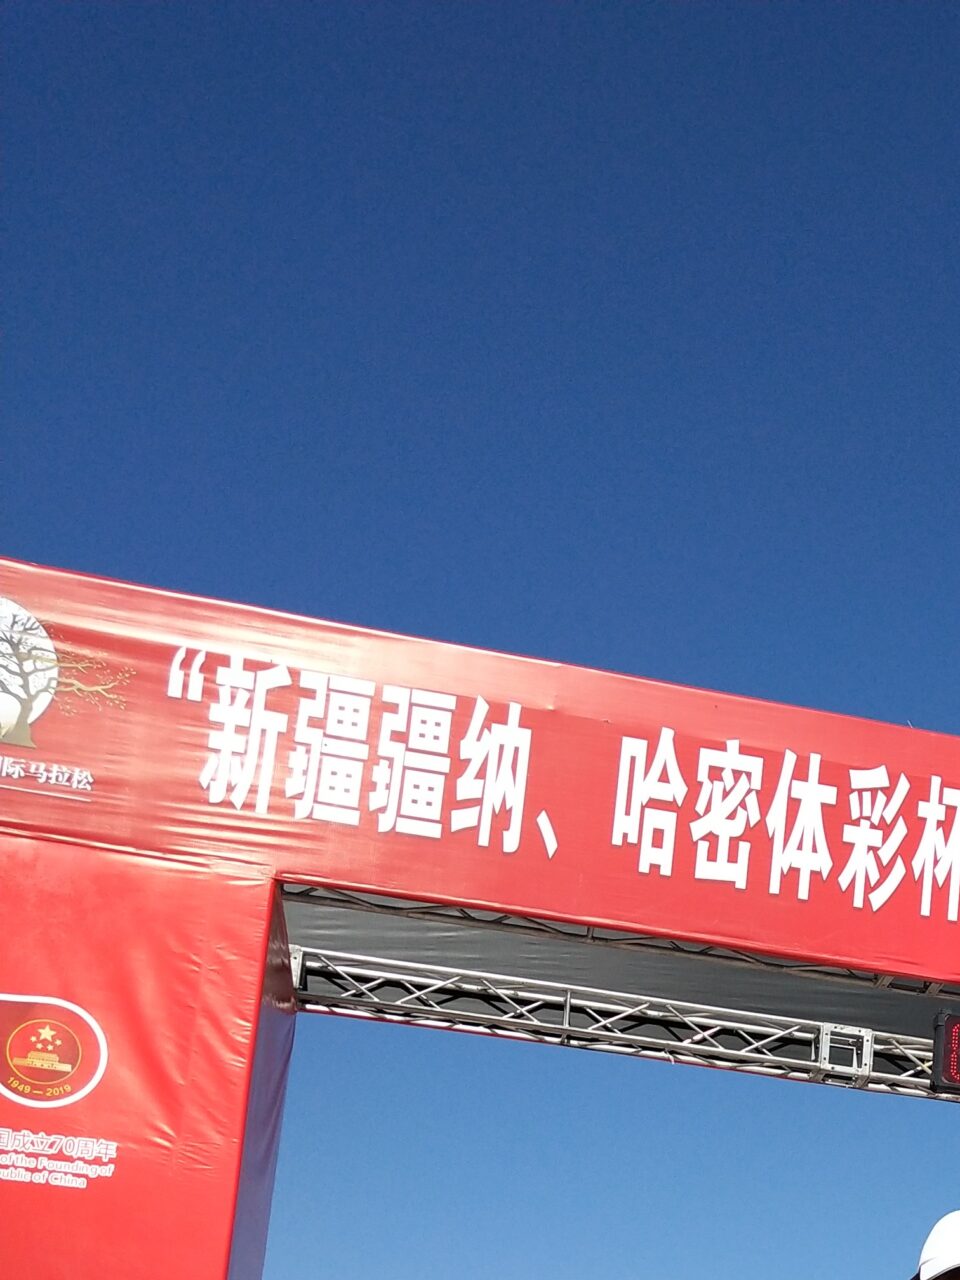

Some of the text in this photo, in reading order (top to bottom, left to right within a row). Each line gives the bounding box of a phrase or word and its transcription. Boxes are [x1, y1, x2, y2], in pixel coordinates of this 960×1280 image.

[0, 756, 94, 791] 际马拉松
[0, 1168, 88, 1189] ublic of China
[38, 1157, 98, 1179] Founding
